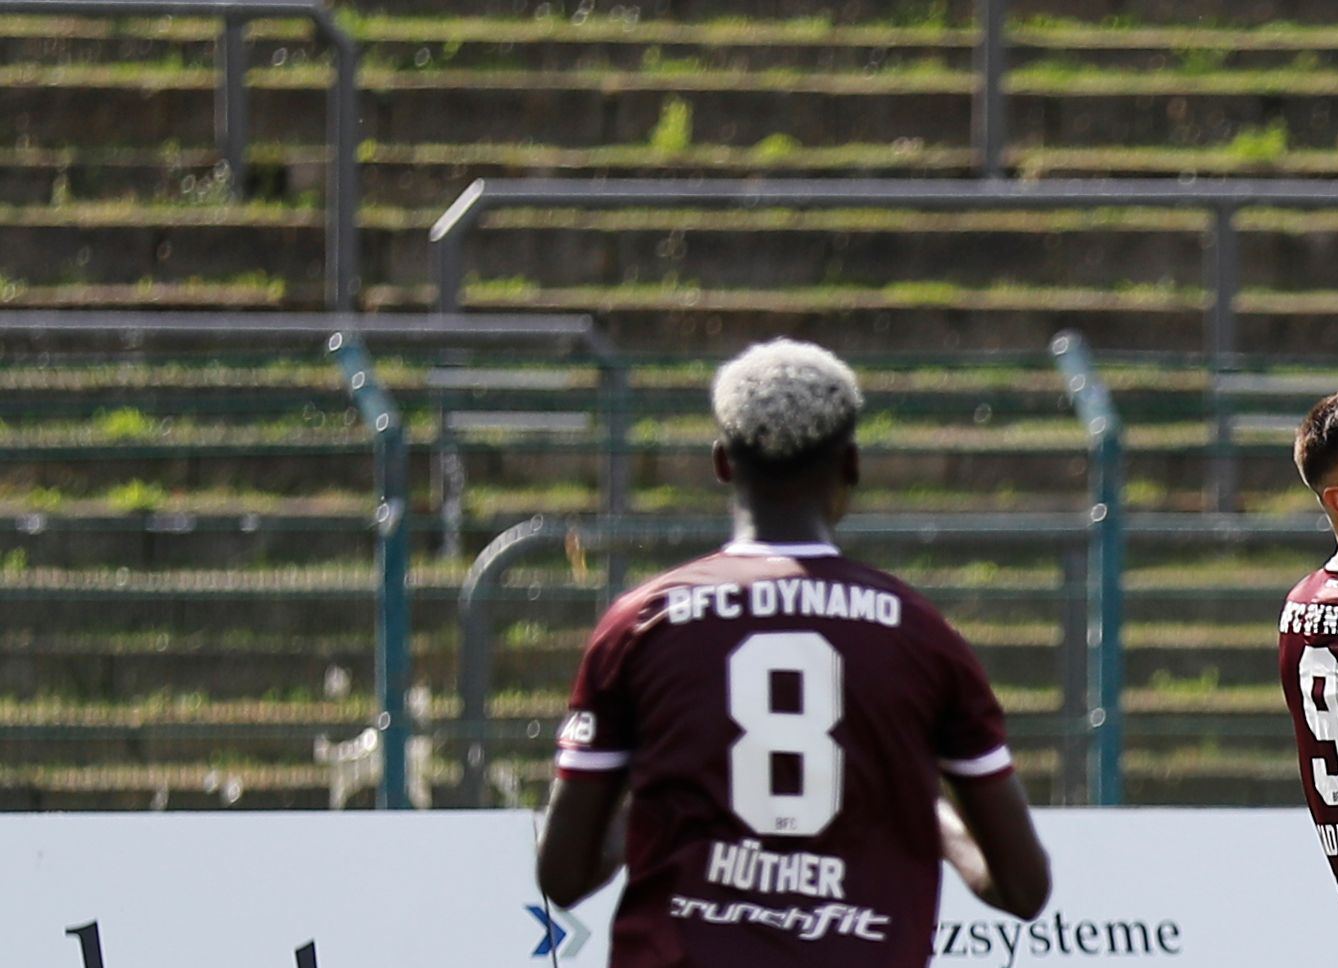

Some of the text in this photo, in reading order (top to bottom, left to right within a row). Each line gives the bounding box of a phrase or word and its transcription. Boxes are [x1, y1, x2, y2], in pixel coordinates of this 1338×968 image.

[668, 577, 901, 627] BFC DYNAMO
[727, 630, 846, 837] 8
[706, 838, 846, 899] HÜTHER
